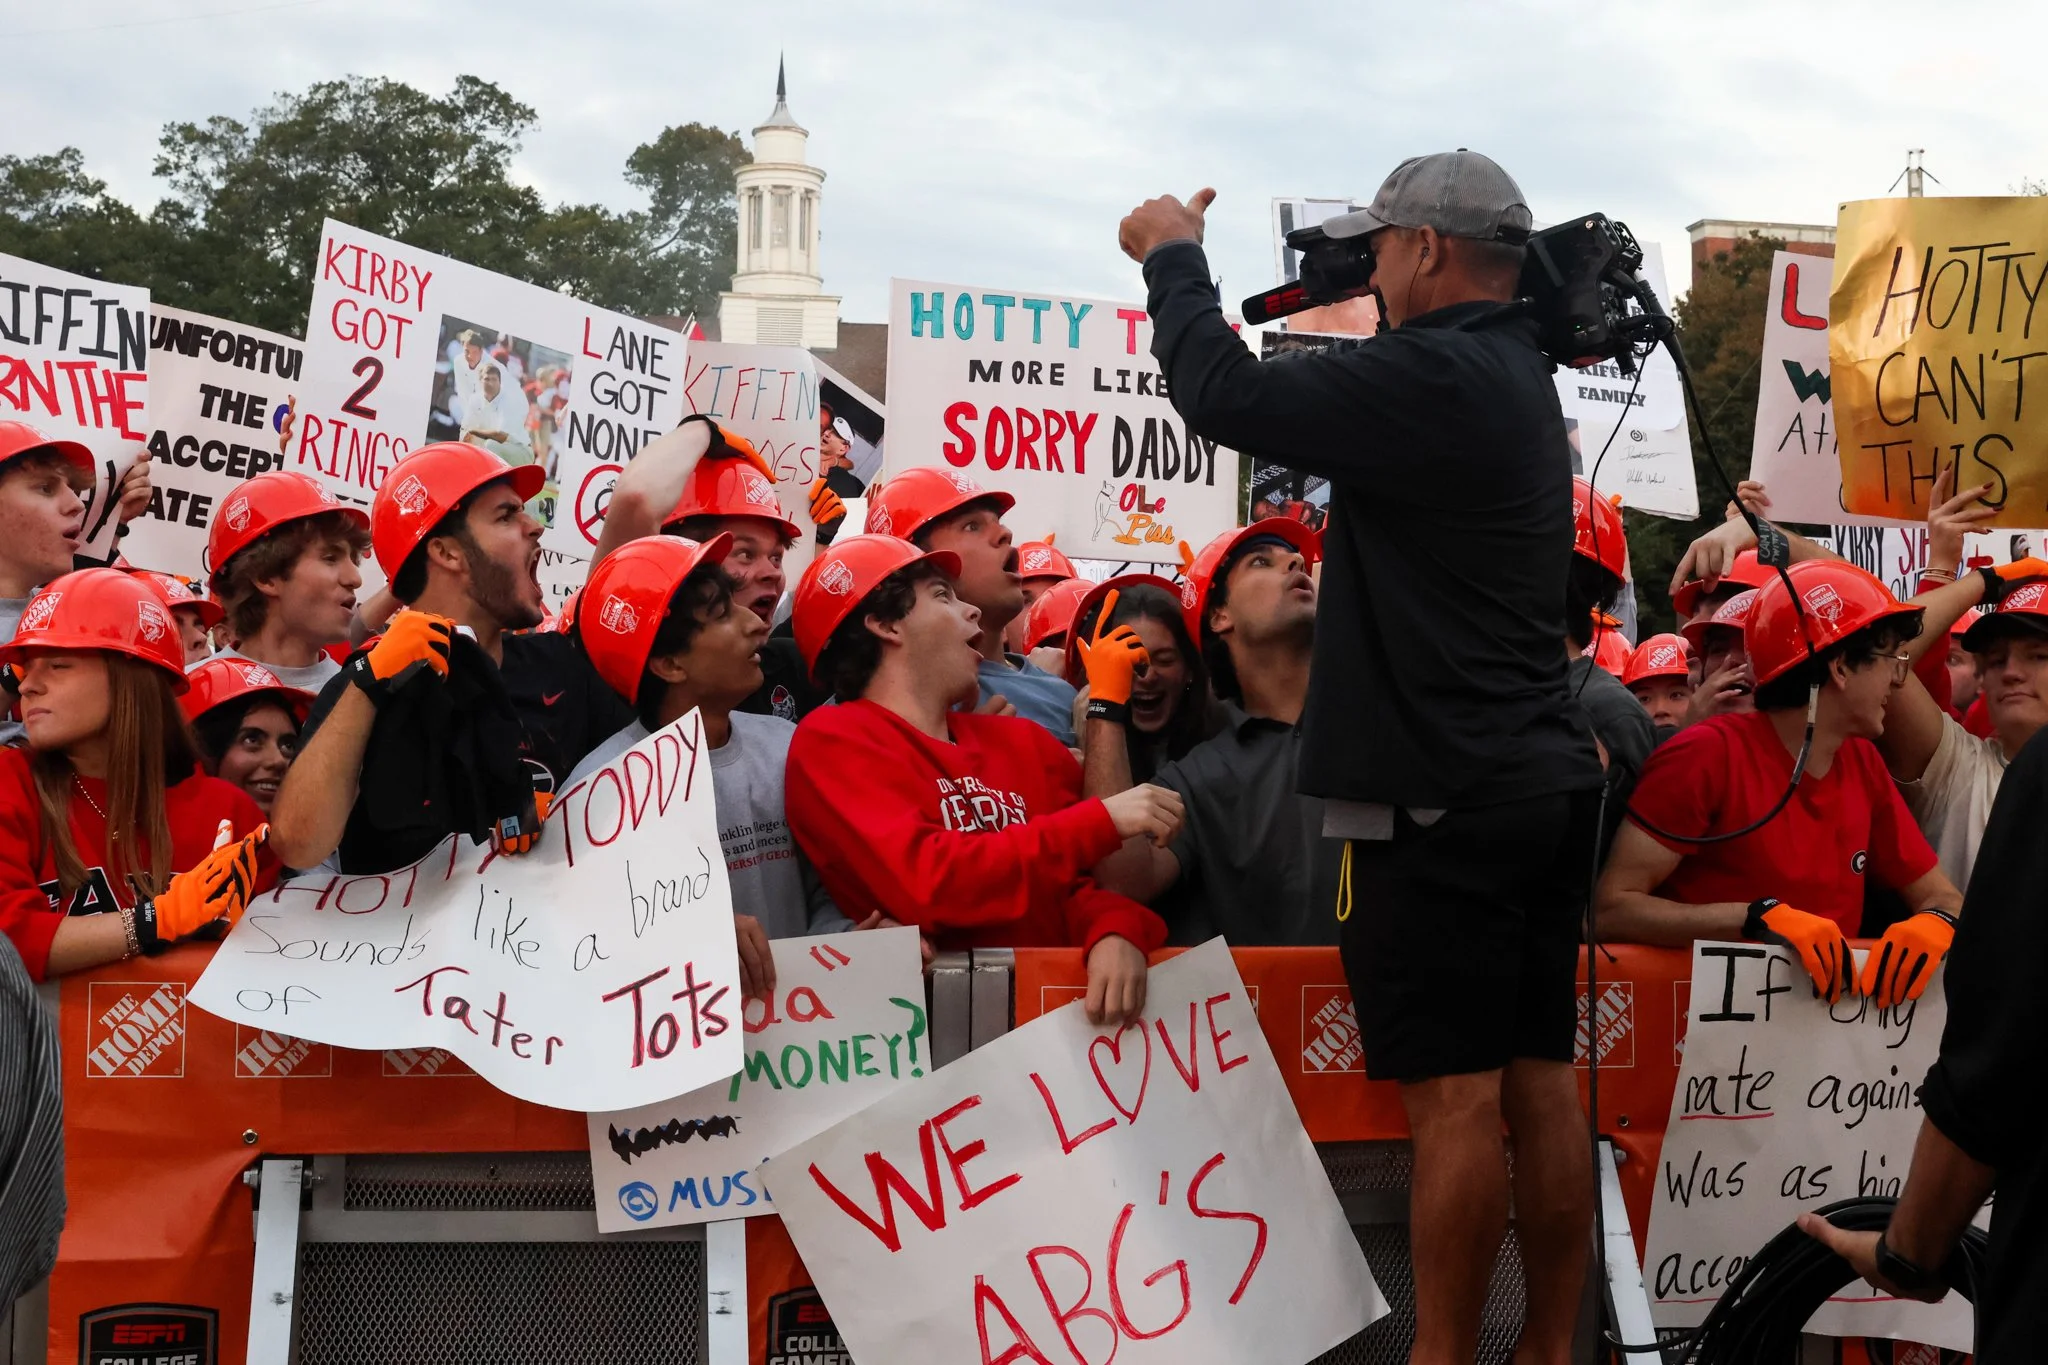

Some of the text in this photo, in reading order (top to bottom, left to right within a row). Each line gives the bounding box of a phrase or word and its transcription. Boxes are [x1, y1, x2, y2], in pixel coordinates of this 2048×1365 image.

[323, 237, 433, 312] KIRBY
[1873, 242, 2048, 339] HOTTY
[0, 277, 147, 371] IFFIN
[332, 299, 413, 359] GOT
[583, 316, 671, 382] LANE
[911, 292, 1093, 349] HOTTY
[199, 383, 268, 430] THE
[341, 357, 384, 421] 2
[590, 371, 668, 421] GOT
[684, 355, 817, 421] KIFFIN
[968, 359, 1170, 398] MORE LIKE
[1578, 386, 1646, 407] FAMILY
[1876, 349, 2048, 426] CAN'T
[298, 413, 409, 492] RINGS
[744, 437, 816, 485] OGS
[943, 401, 1220, 486] SORRY DADDY
[1778, 412, 1838, 454] At
[1861, 433, 2014, 508] THIS
[20, 594, 60, 631] HOME
[546, 713, 701, 868] TODDY
[732, 839, 756, 855] and
[244, 846, 711, 972] Sounds like a brand
[99, 993, 139, 1030] THE
[236, 962, 730, 1069] of Tater Tots
[1311, 995, 1345, 1030] THE
[1699, 947, 1793, 1022] If
[88, 983, 186, 1077] HOME
[125, 1017, 185, 1077] DEPOT
[729, 996, 926, 1101] MONEY?
[1684, 1045, 1774, 1115] rate
[808, 1095, 1023, 1253] WE
[1780, 1164, 1832, 1200] as
[974, 1152, 1268, 1365] ABG'S
[1654, 1253, 1750, 1299] acce
[112, 1323, 186, 1345] ESPN
[785, 1334, 848, 1353] COLLE
